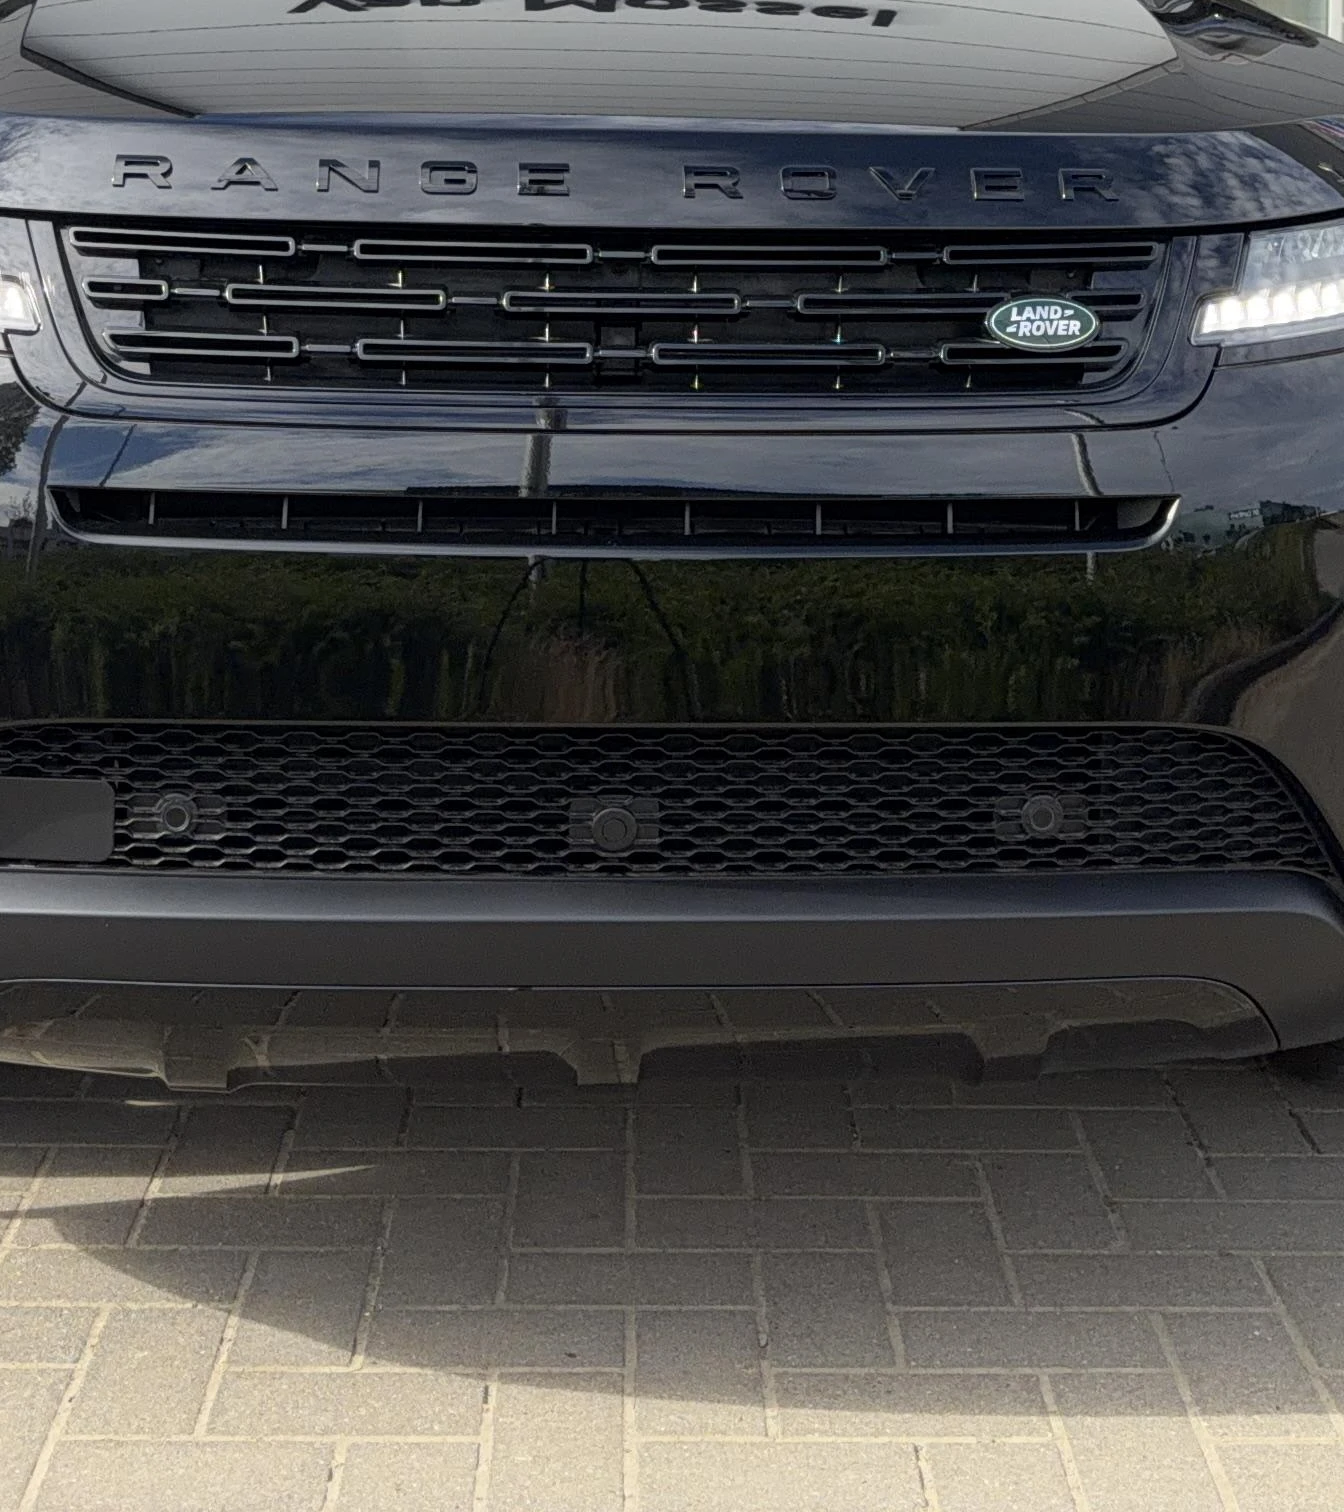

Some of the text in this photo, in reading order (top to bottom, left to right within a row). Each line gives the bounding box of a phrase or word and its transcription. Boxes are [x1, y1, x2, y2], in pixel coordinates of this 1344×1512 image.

[112, 154, 1120, 202] RANGE ROVER
[1011, 305, 1062, 321] LAND
[1018, 320, 1081, 337] ROVER
